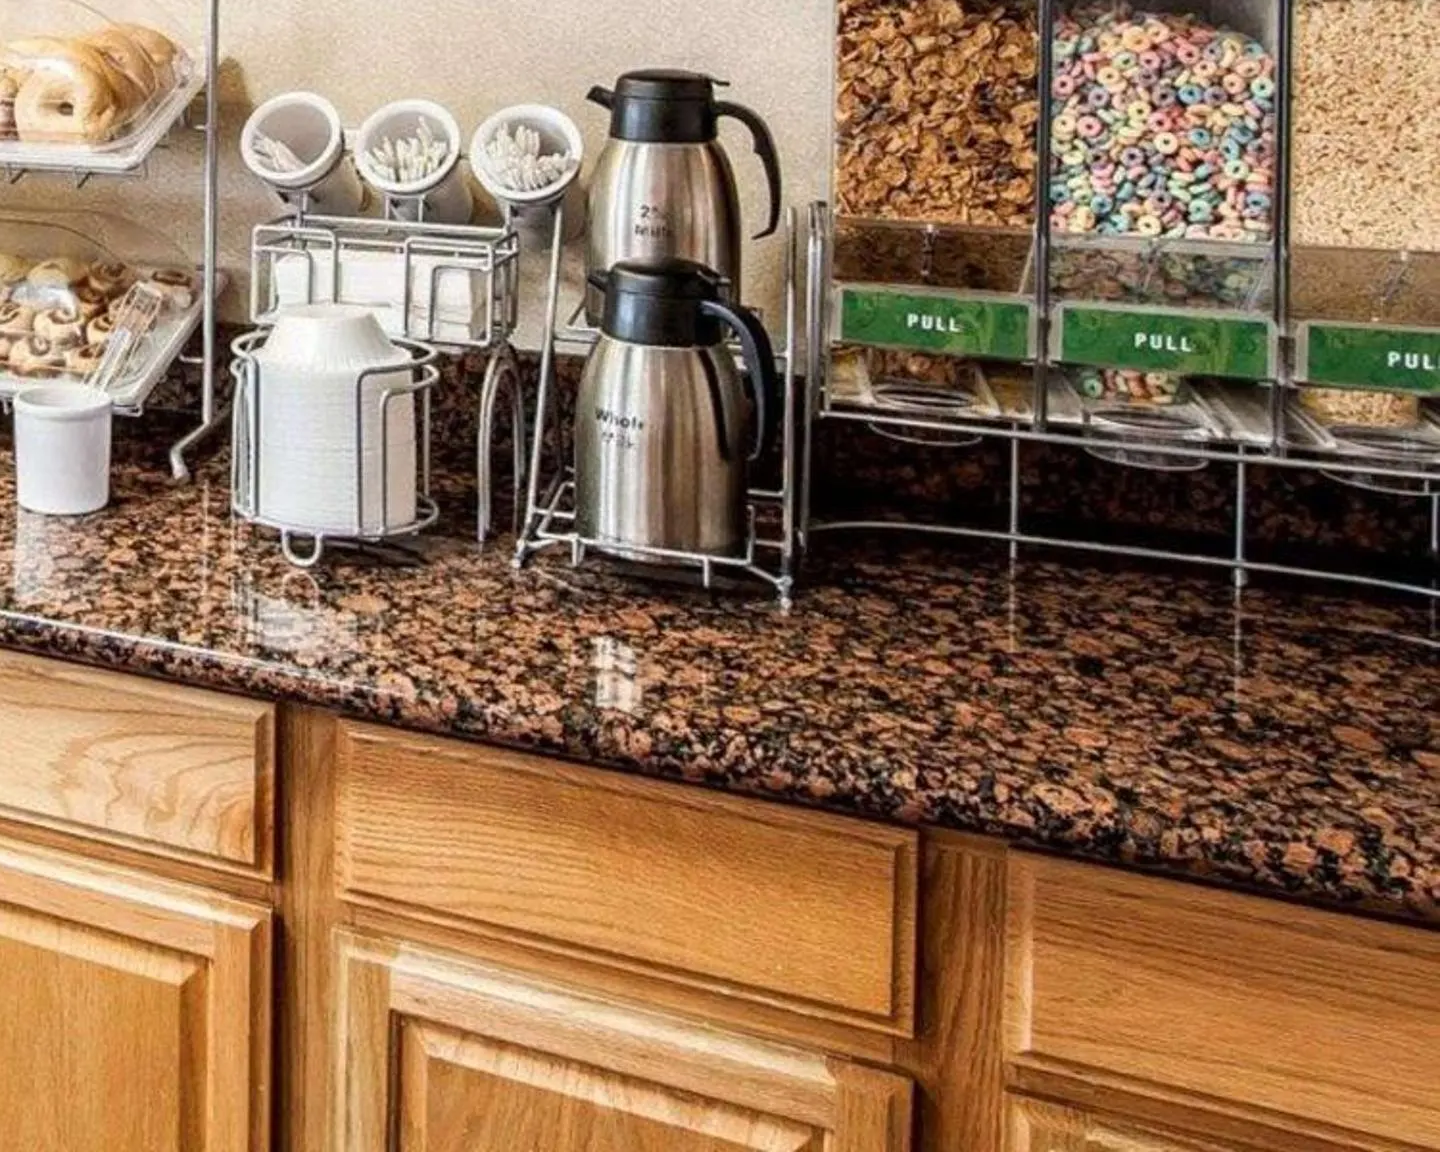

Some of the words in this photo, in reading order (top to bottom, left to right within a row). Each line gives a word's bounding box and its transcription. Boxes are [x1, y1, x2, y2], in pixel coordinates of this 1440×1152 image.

[907, 313, 960, 333] PULL
[1134, 333, 1191, 353] PULL
[1387, 350, 1440, 372] PUL
